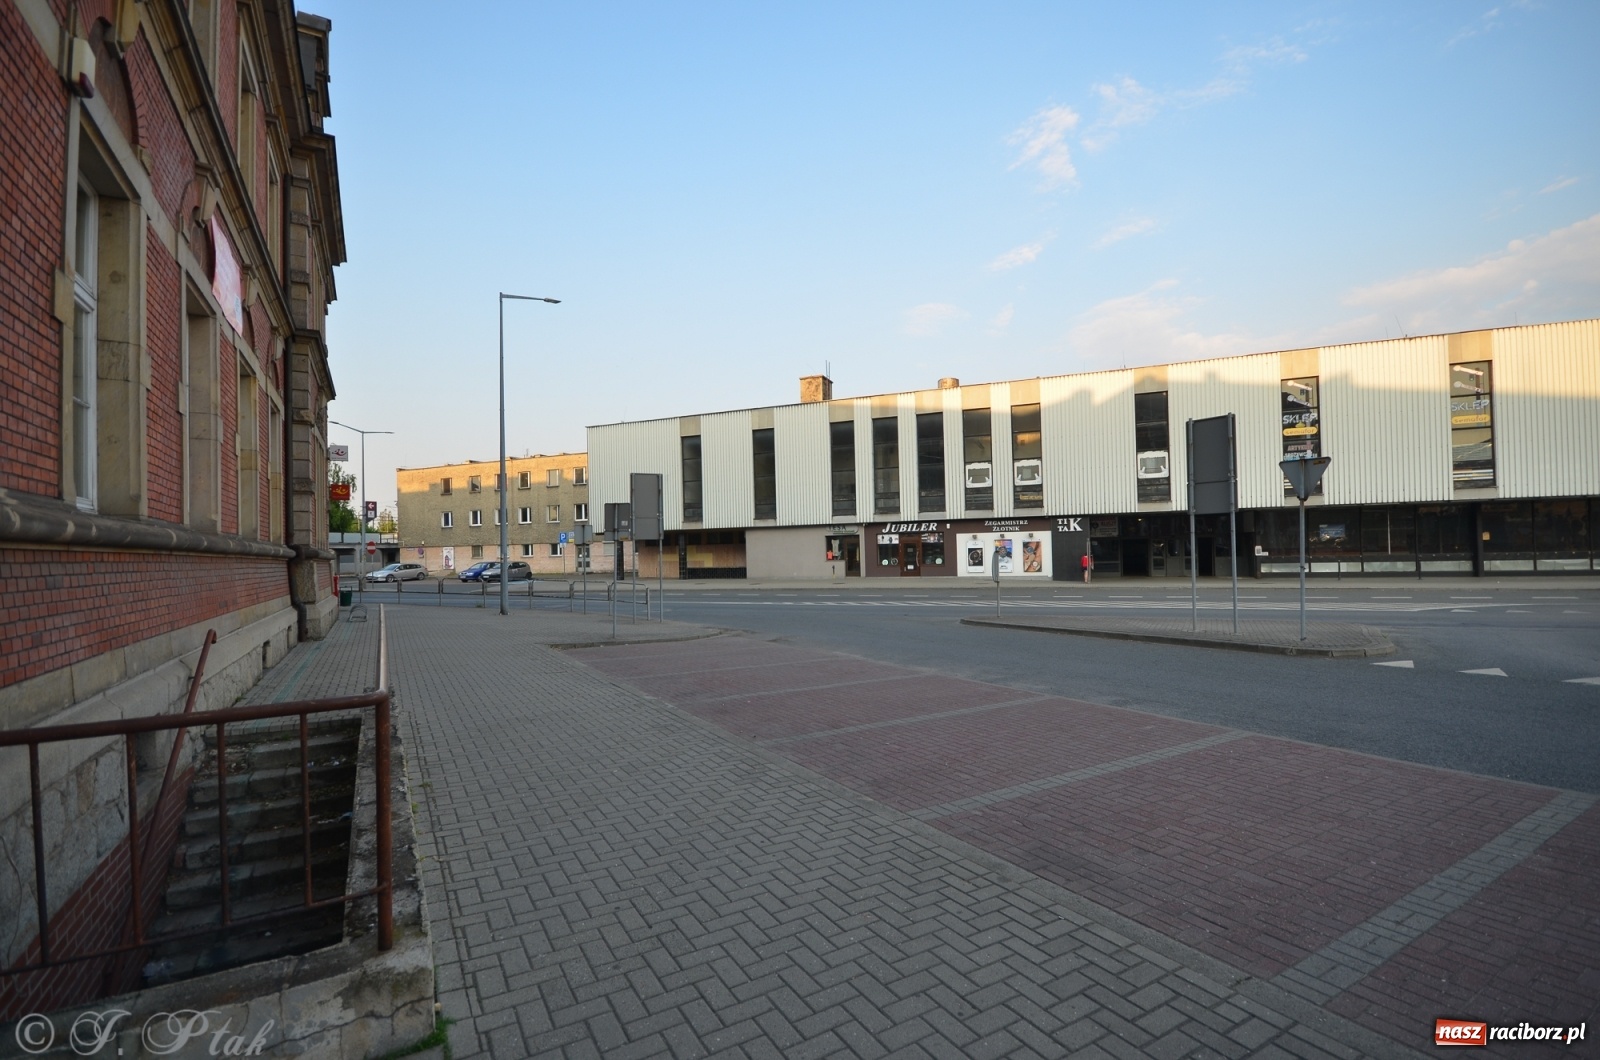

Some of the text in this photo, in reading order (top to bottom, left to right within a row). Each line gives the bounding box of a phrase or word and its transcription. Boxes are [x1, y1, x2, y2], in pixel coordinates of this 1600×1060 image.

[1451, 399, 1489, 412] SKLEP
[1282, 412, 1318, 425] SKLEP
[882, 522, 938, 533] JUBILER
